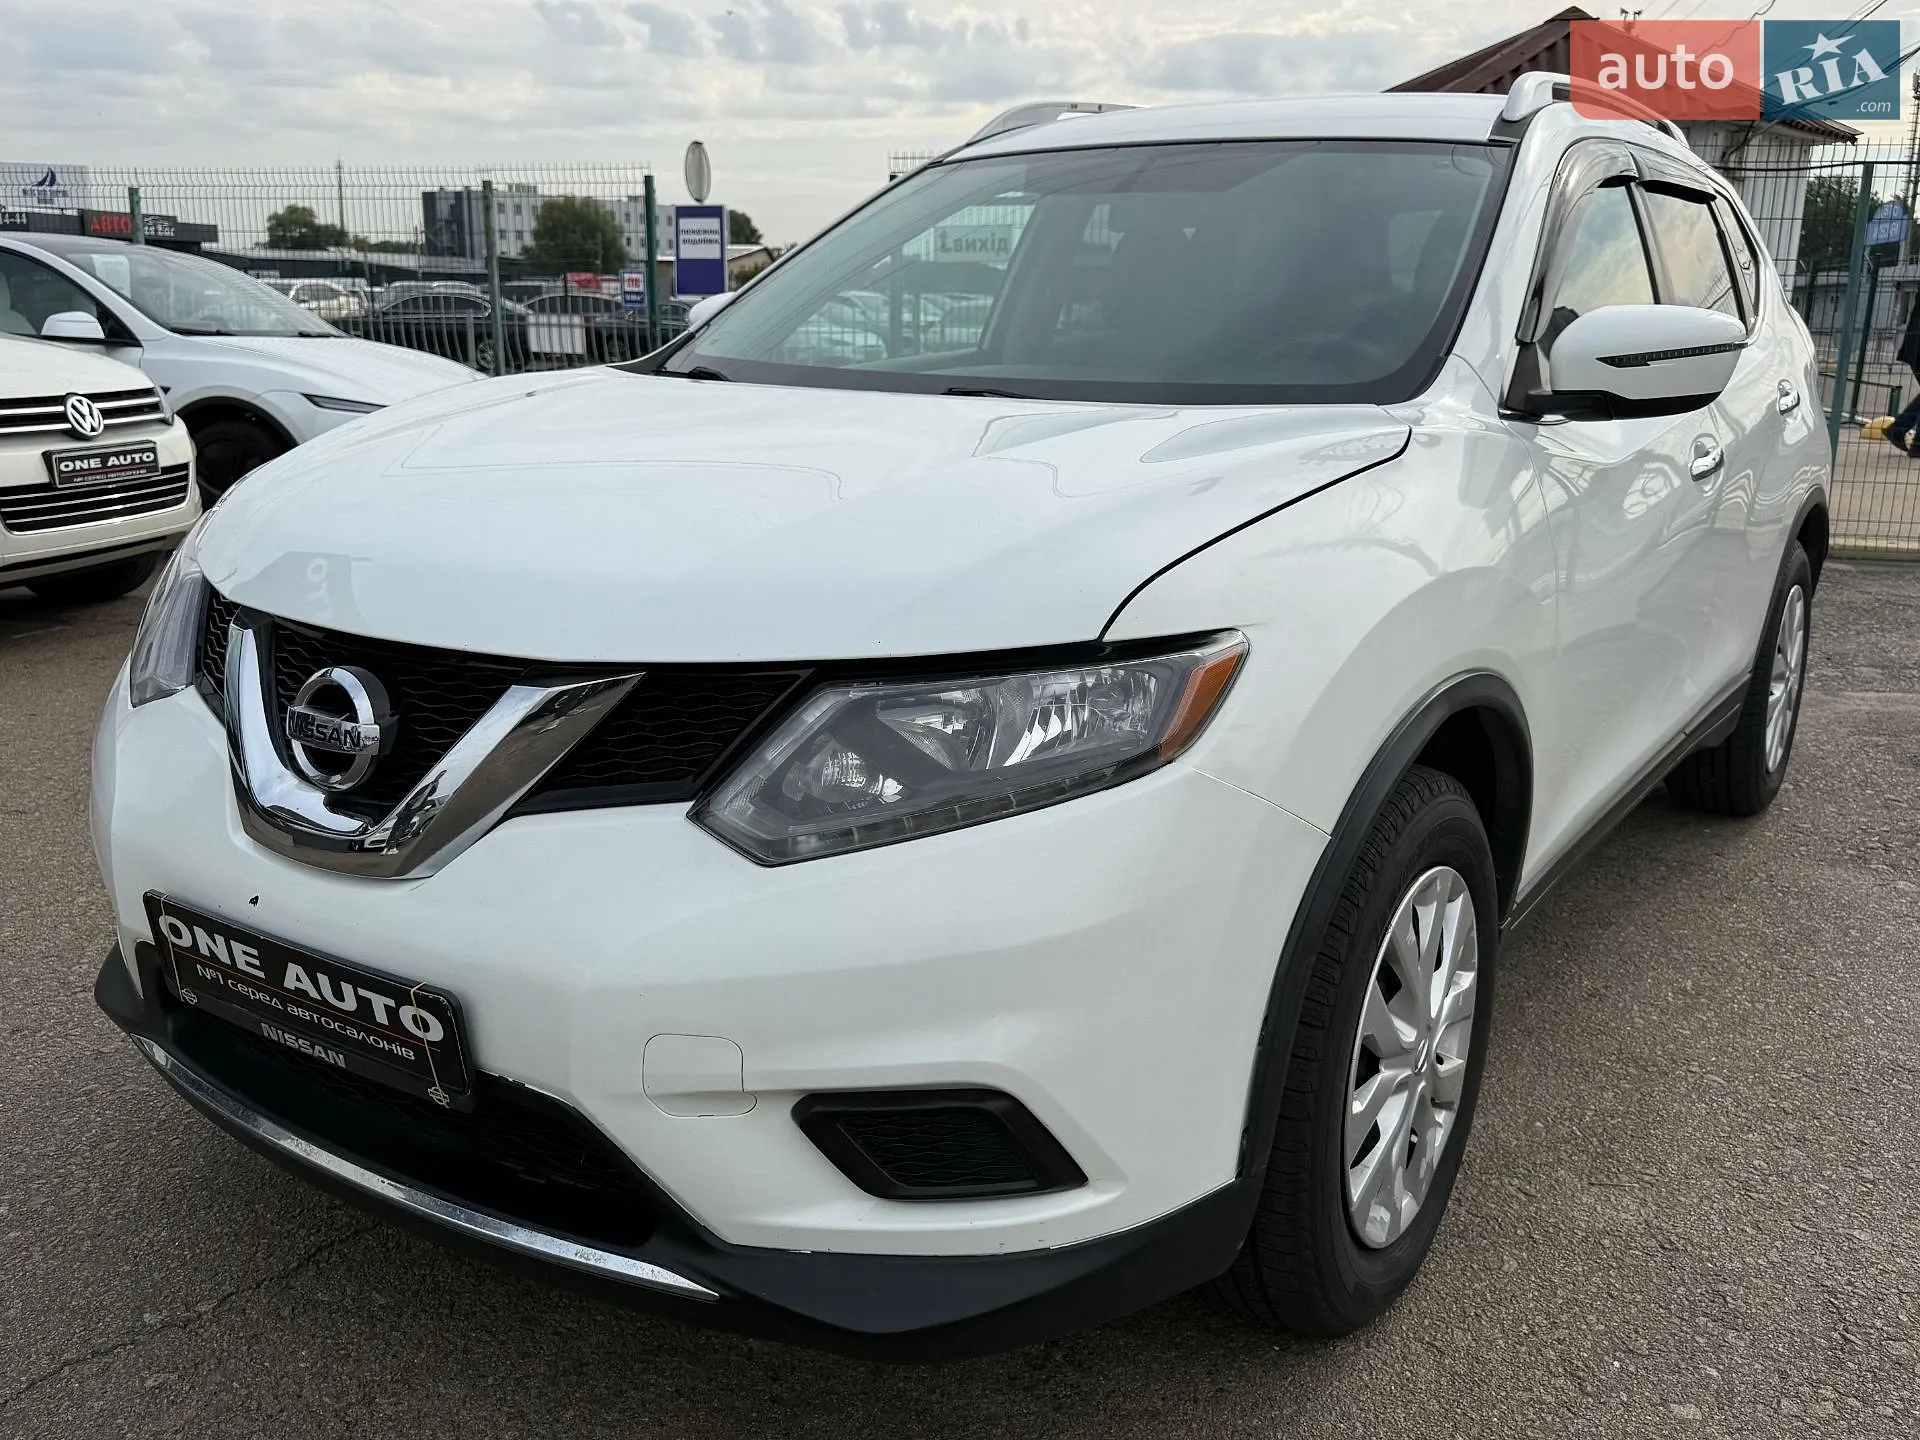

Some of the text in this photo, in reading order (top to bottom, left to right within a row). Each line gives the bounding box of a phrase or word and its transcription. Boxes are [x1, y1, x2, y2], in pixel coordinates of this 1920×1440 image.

[59, 451, 155, 472] ONE AUTO
[287, 708, 363, 749] NISSAN
[158, 914, 445, 1043] ONE AUTO
[227, 978, 285, 1011] серед
[286, 1002, 417, 1062] автосалонів
[260, 1021, 347, 1069] NISSAN
